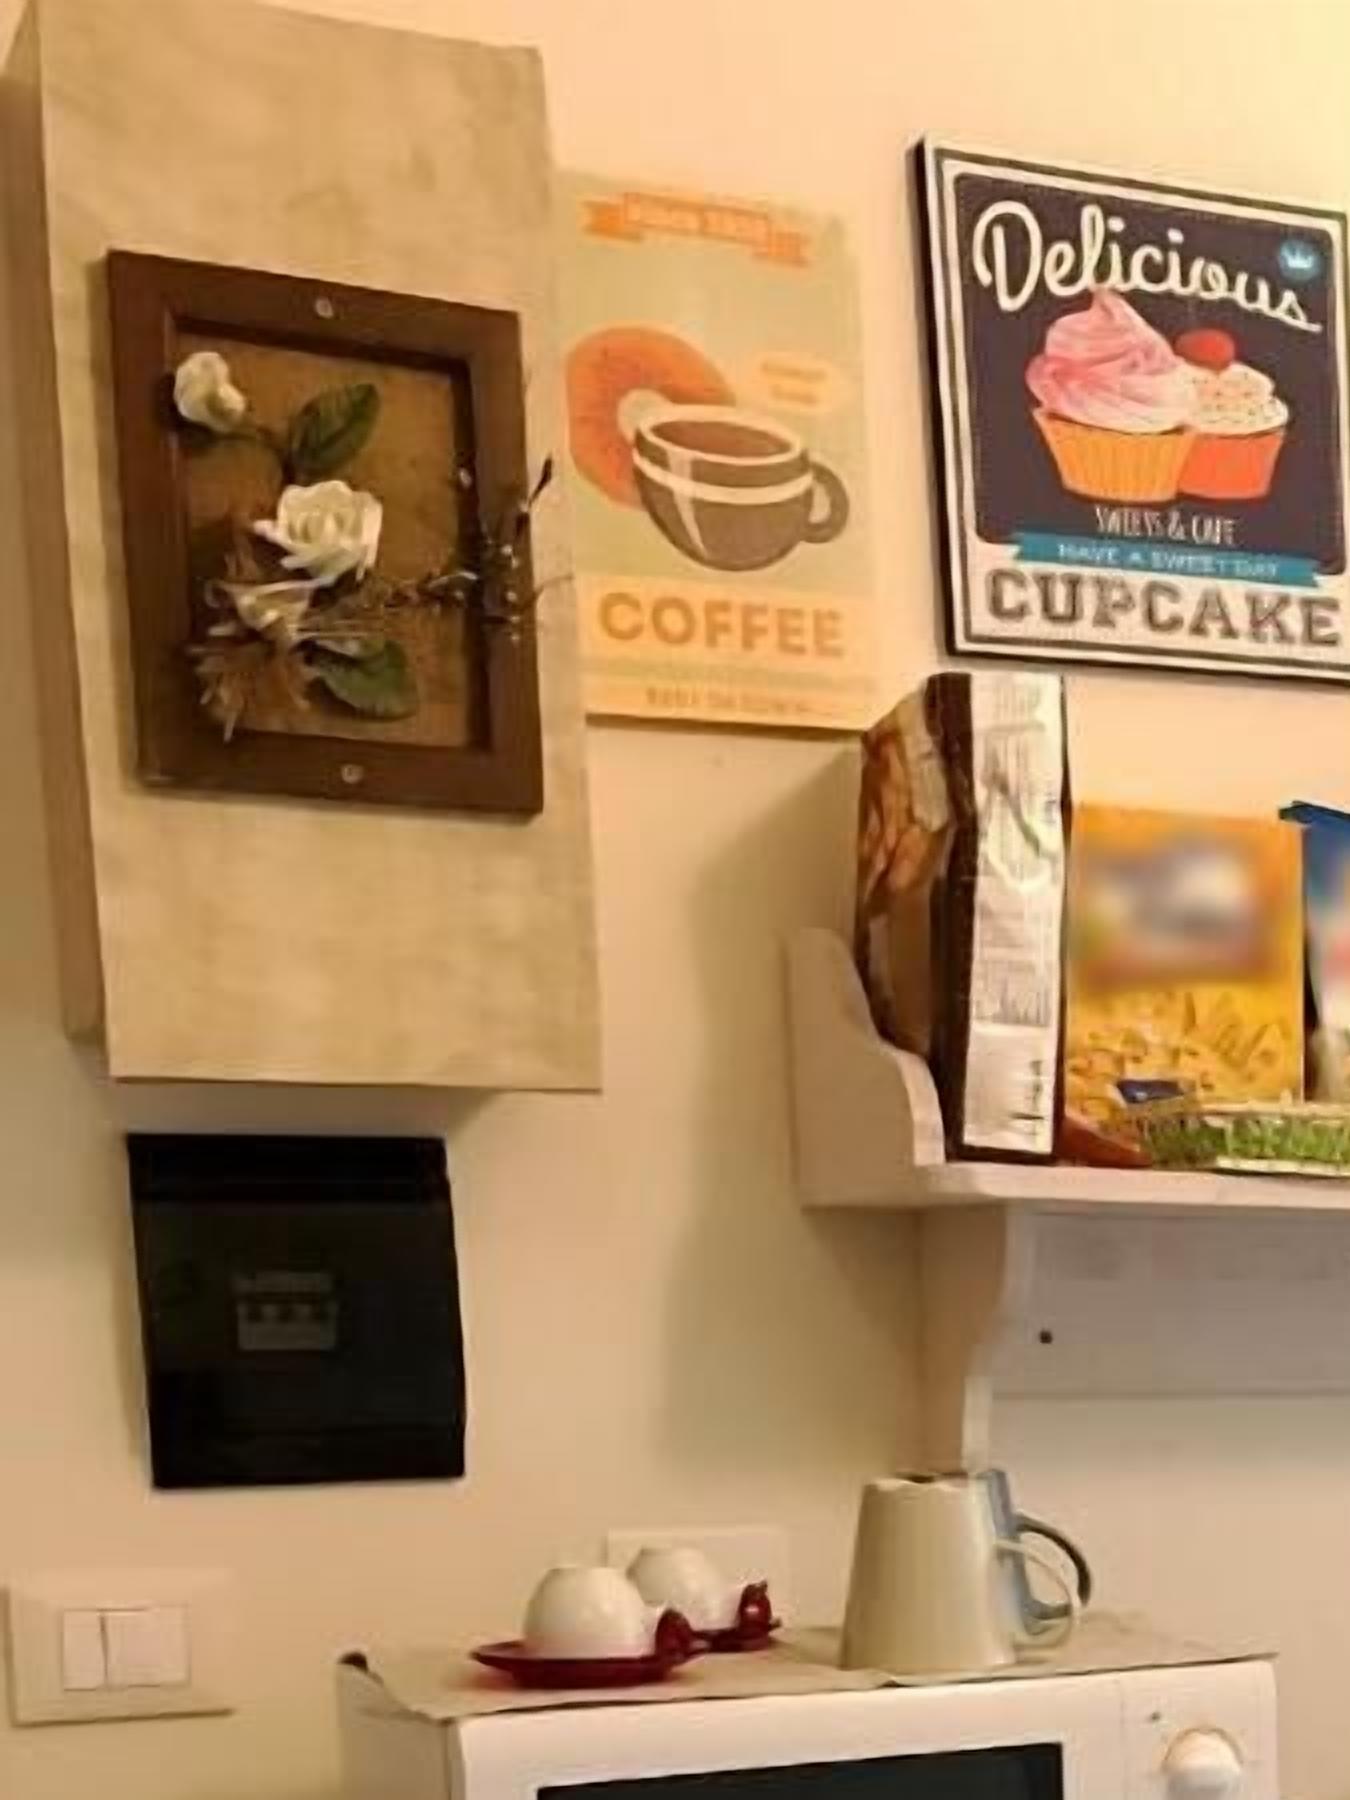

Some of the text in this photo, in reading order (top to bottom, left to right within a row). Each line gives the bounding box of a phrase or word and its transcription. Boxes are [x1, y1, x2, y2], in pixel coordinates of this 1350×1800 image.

[972, 200, 1322, 334] Delicious
[599, 591, 846, 657] COFFEE
[985, 566, 1342, 648] CUPCAKE
